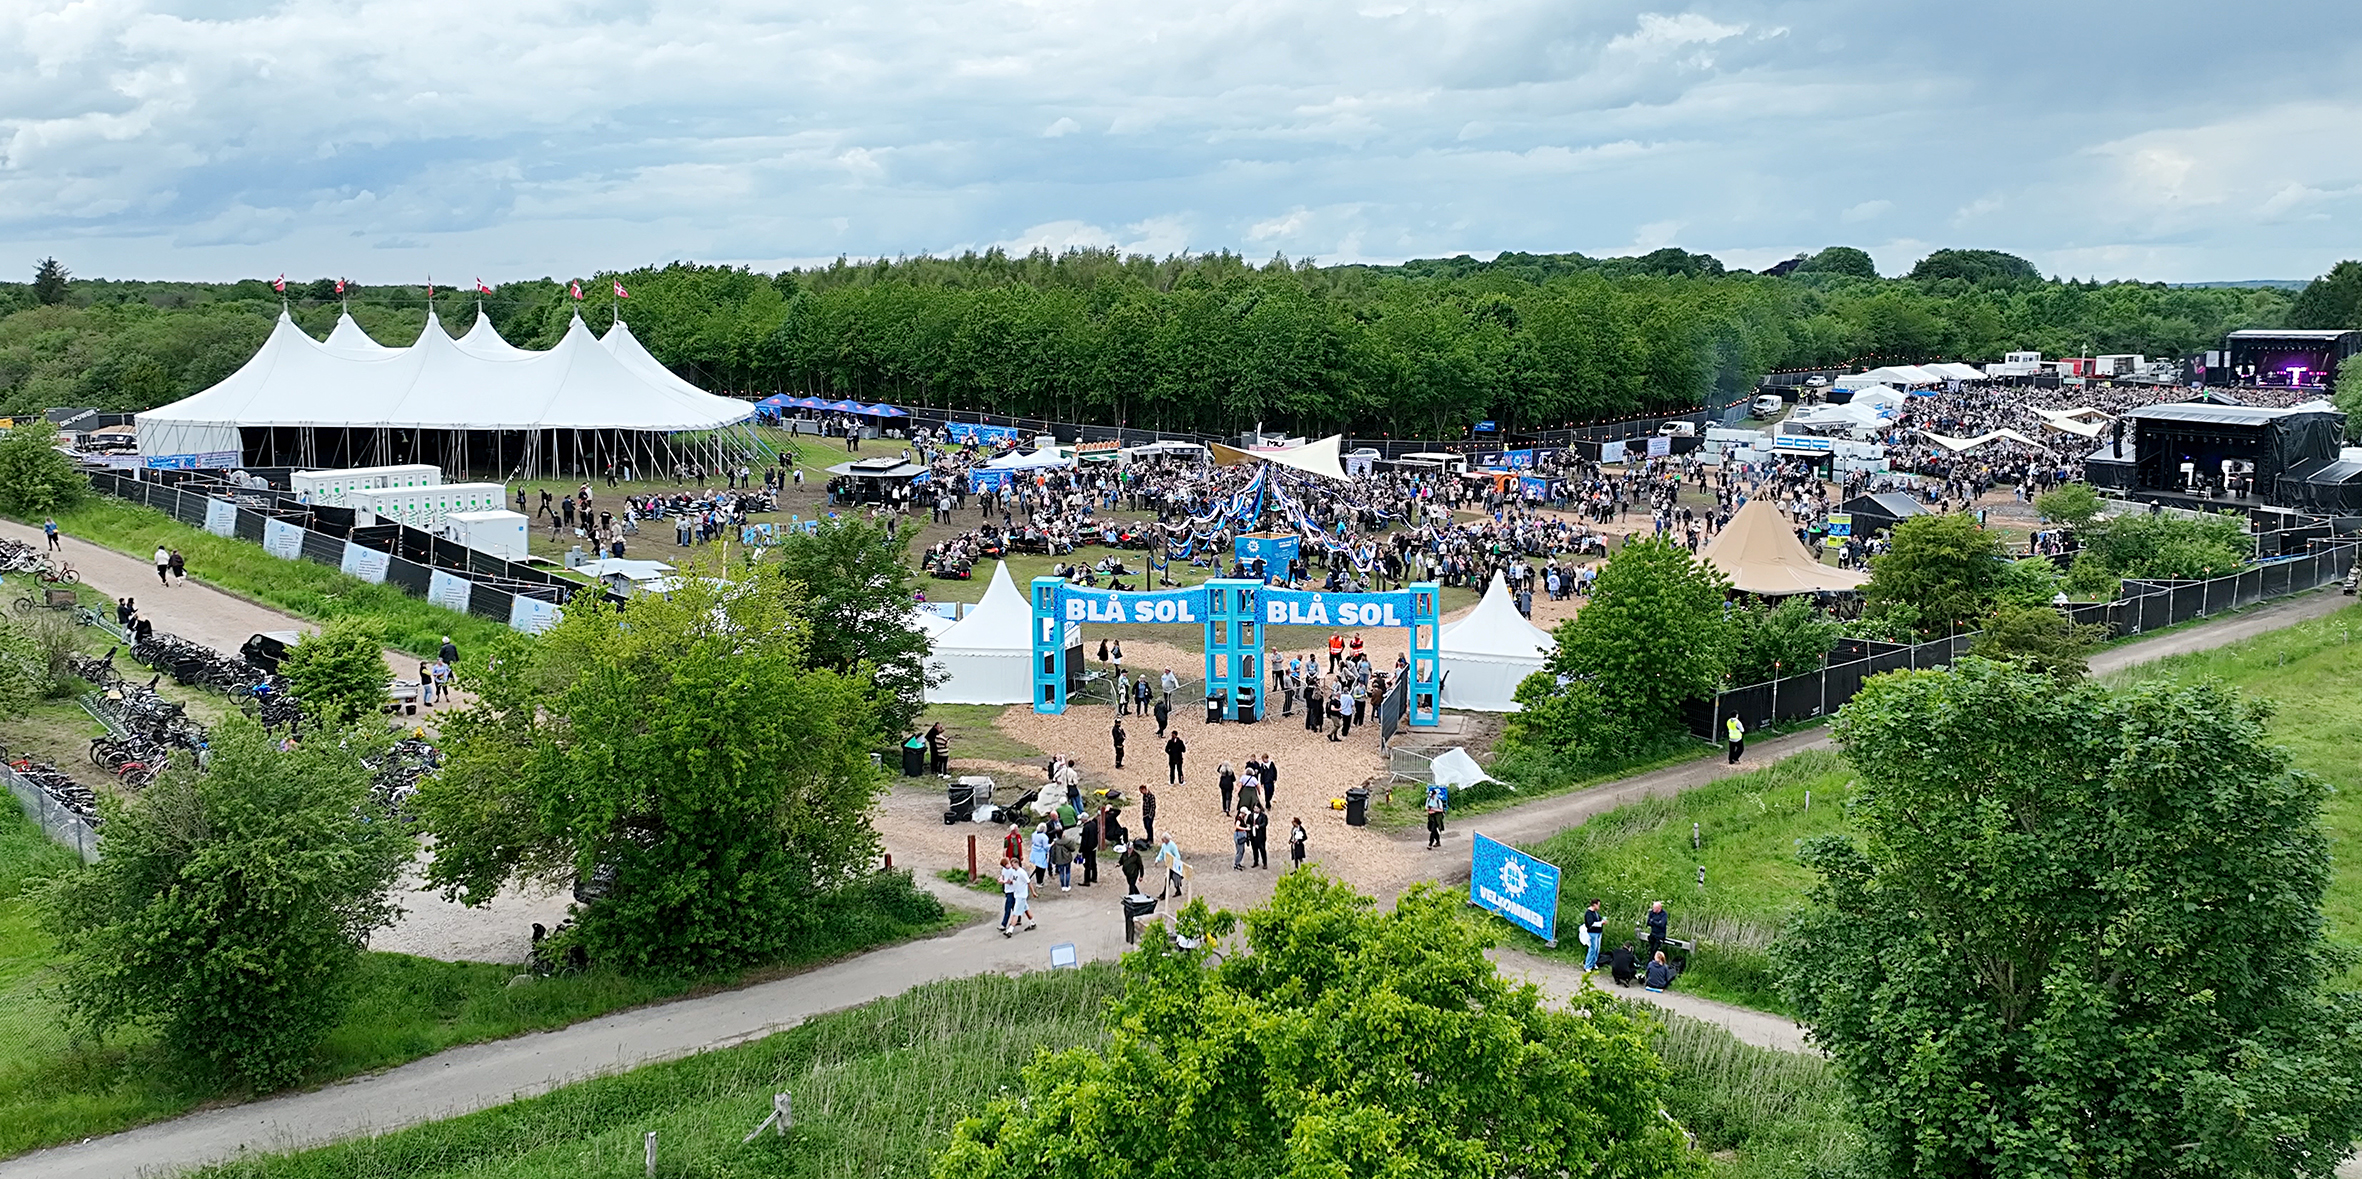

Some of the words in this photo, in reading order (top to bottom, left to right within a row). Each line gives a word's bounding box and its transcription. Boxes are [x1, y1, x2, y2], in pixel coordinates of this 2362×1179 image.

[71, 409, 96, 422] POWER
[1066, 594, 1126, 621] BLÅ
[1135, 600, 1195, 622] SOL
[1267, 593, 1329, 624] BLÅ
[1338, 603, 1401, 626] SOL
[1507, 876, 1520, 888] SOL
[1508, 868, 1520, 880] BLÅ
[1479, 884, 1544, 929] VELKOMMEN
